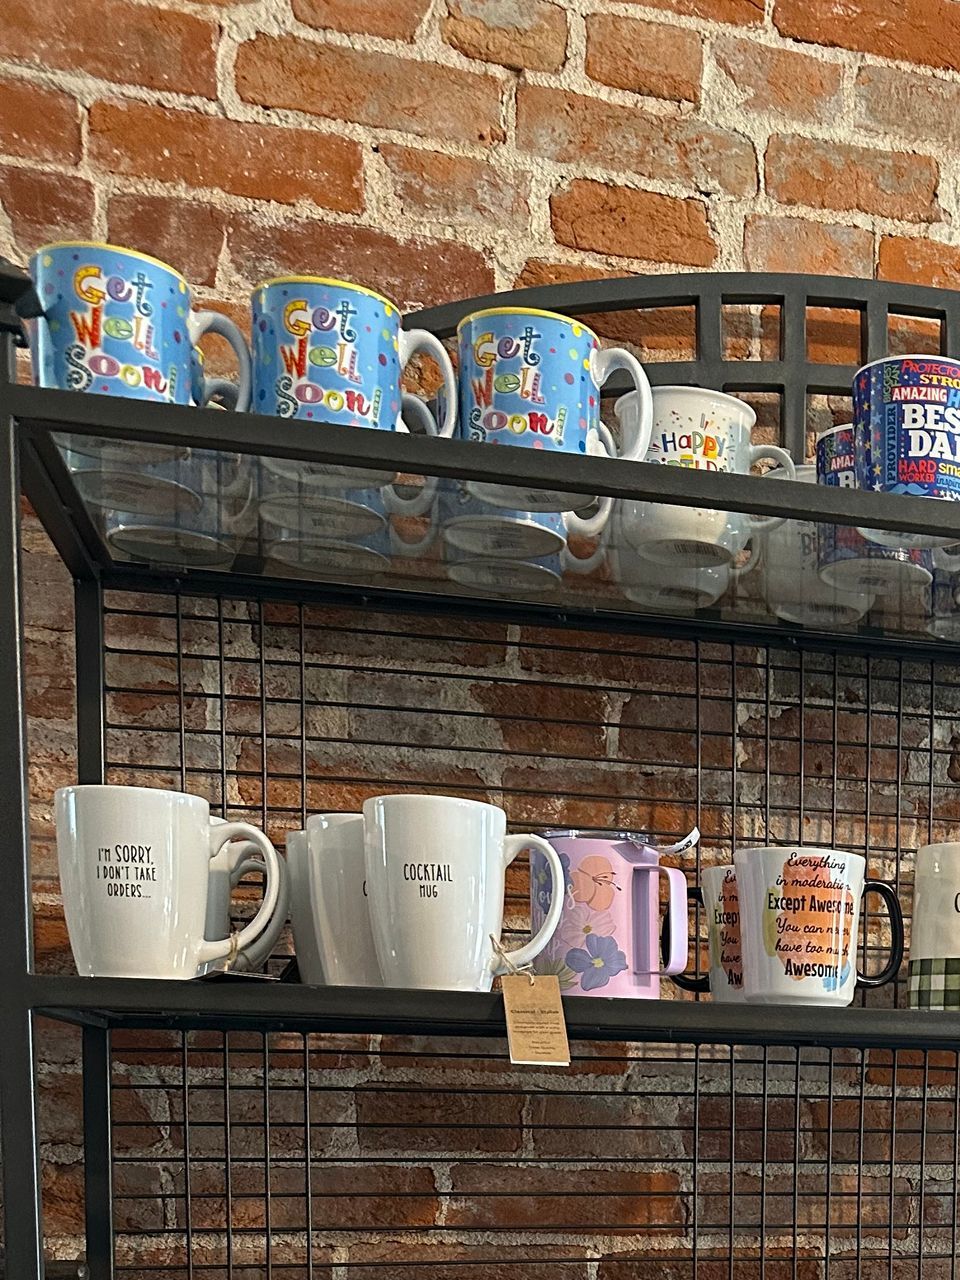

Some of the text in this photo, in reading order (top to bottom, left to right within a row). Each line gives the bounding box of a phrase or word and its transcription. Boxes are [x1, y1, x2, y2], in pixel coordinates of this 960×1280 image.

[73, 265, 153, 317] Get
[283, 299, 357, 344] Get
[472, 326, 541, 367] Get
[892, 387, 948, 402] AMAZING
[886, 405, 897, 483] PROVIDER
[898, 460, 936, 473] HARD
[898, 472, 935, 483] WORKER
[98, 845, 154, 865] I'M SORRY,
[787, 852, 846, 874] Everything
[103, 866, 129, 880] DON'T
[135, 866, 157, 881] TAKE
[404, 863, 453, 882] COCKTAIL
[776, 875, 787, 886] in
[419, 883, 438, 898] MUG
[768, 893, 805, 914] Except
[775, 918, 824, 935] You can
[720, 931, 738, 946] You
[775, 939, 824, 954] have too
